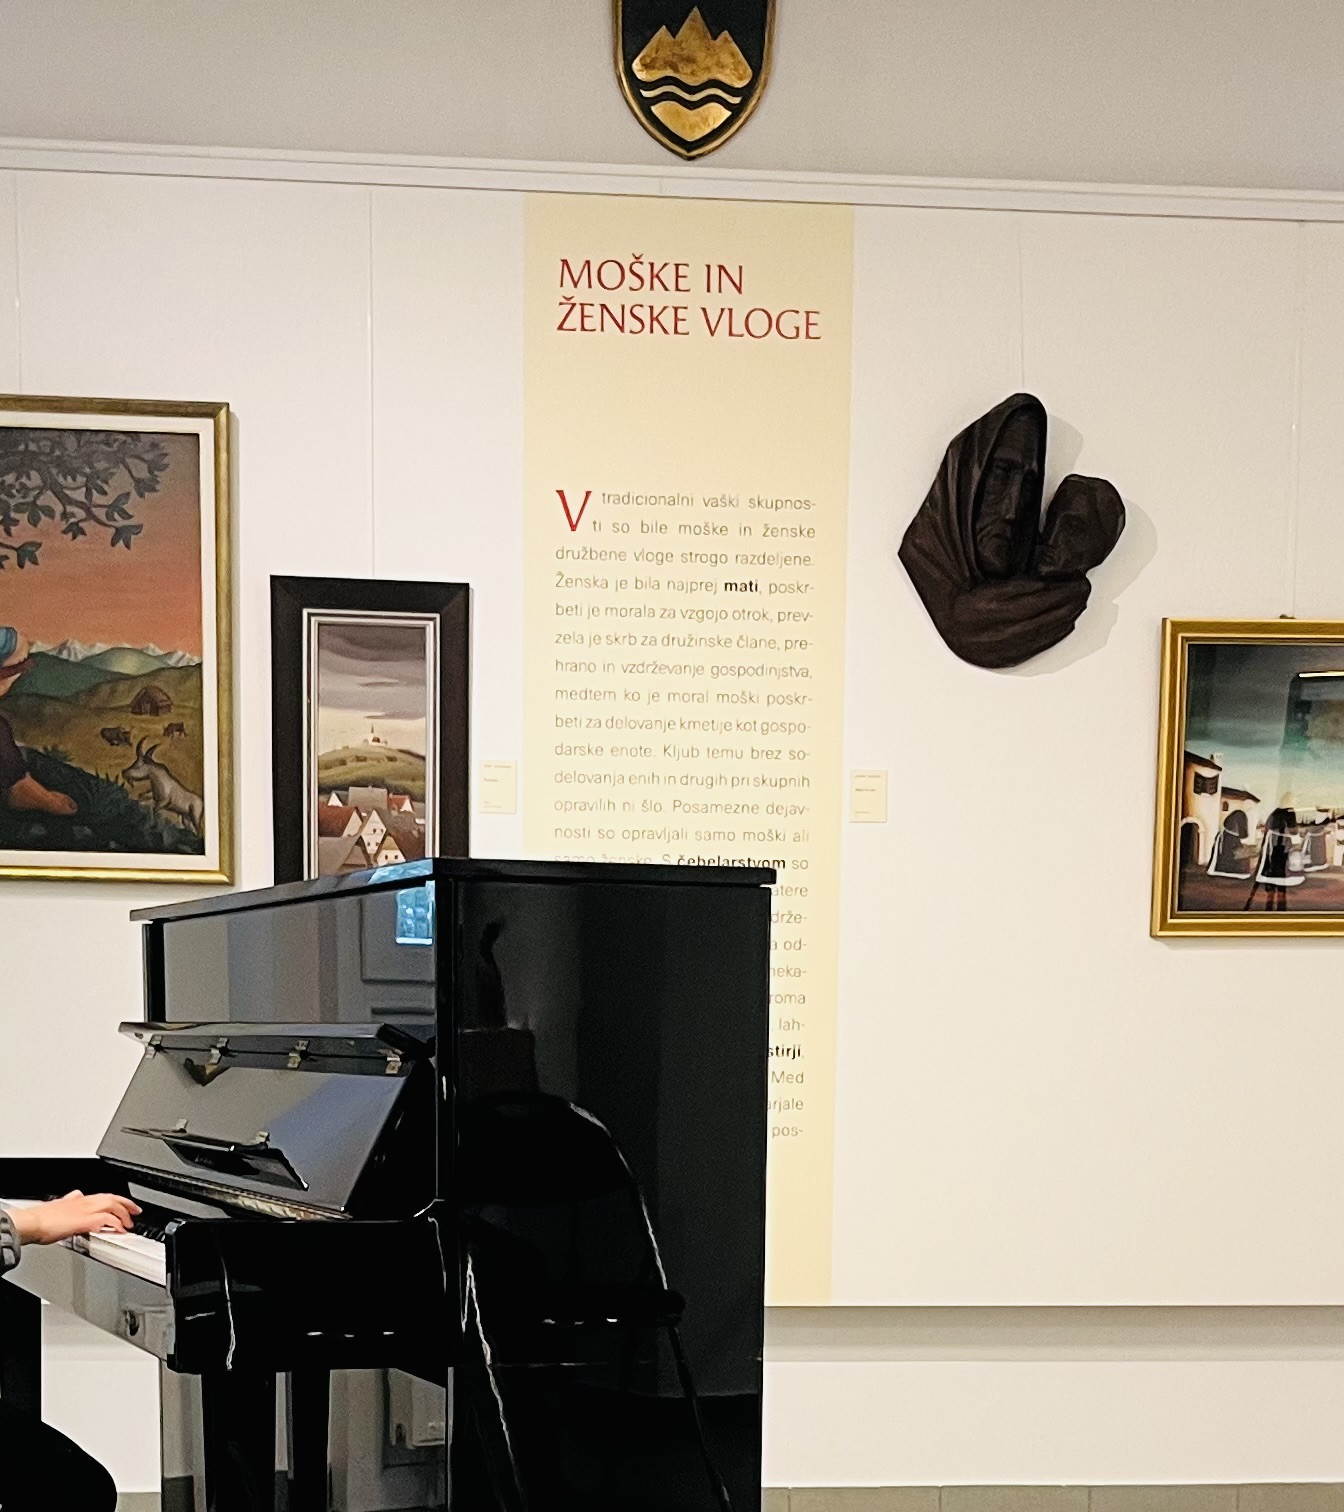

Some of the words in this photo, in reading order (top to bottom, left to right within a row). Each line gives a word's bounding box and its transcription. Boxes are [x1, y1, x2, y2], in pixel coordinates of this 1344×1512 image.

[560, 253, 691, 292] MOŠKE
[705, 264, 744, 294] IN
[557, 296, 690, 335] ŽENSKE
[701, 307, 821, 339] VLOGE
[556, 490, 592, 531] V
[602, 492, 694, 507] tradicionalni
[702, 493, 739, 508] vaški
[748, 494, 816, 512] skupnos-
[592, 520, 601, 532] ti
[612, 522, 630, 534] so
[640, 520, 668, 534] bile
[678, 521, 728, 536] moške
[739, 522, 752, 536] in
[762, 523, 816, 538] ženske
[556, 546, 626, 562] družbene
[634, 549, 674, 565] vloge
[680, 550, 728, 565] strogo
[736, 550, 815, 568] razdeljene.
[556, 571, 608, 589] Ženska
[616, 576, 628, 592] je
[634, 576, 660, 590] bila
[667, 577, 718, 594] najprej
[724, 580, 762, 594] mati,
[768, 580, 814, 595] poskr-
[556, 603, 582, 617] beti
[588, 604, 600, 619] je
[605, 604, 656, 618] morala
[660, 608, 676, 620] za
[680, 608, 728, 624] vzgojo
[732, 607, 773, 622] otrok,
[777, 610, 813, 623] prev-
[555, 632, 584, 645] zela
[588, 632, 601, 648] je
[606, 632, 636, 646] skrb
[641, 636, 657, 646] za
[661, 634, 732, 649] družinske
[736, 635, 780, 650] člane,
[784, 638, 813, 651] pre-
[556, 659, 596, 673] hrano
[603, 660, 614, 674] in
[622, 660, 704, 678] vzdrževanje
[710, 663, 812, 679] gospodinjstva,
[556, 688, 616, 701] medtem
[624, 689, 640, 702] ko
[647, 690, 660, 704] je
[668, 690, 708, 704] moral
[716, 690, 760, 704] moški
[766, 692, 812, 707] poskr-
[556, 714, 582, 728] beti
[586, 718, 602, 729] za
[606, 716, 676, 733] delovanje
[680, 717, 732, 734] kmetije
[736, 718, 756, 732] kot
[760, 721, 812, 735] gospo-
[555, 742, 603, 756] darske
[663, 744, 699, 761] Kljub
[706, 746, 743, 760] temu
[750, 746, 782, 760] brez
[788, 749, 811, 761] so-
[555, 770, 624, 786] delovanja
[629, 772, 660, 785] enih
[664, 773, 676, 786] in
[680, 772, 728, 789] drugih
[731, 774, 749, 789] pri
[753, 774, 810, 790] skupnih
[554, 798, 616, 814] opravilih
[622, 800, 634, 812] ni
[672, 800, 759, 814] Posamezne
[766, 801, 810, 818] dejav-
[554, 826, 590, 840] nosti
[598, 828, 614, 840] so
[622, 827, 688, 844] opravljali
[695, 830, 736, 842] samo
[742, 828, 786, 842] moški
[792, 830, 809, 844] ali
[677, 854, 786, 869] čebelarstvom
[792, 859, 809, 870] so
[771, 885, 809, 898] atere
[768, 1044, 805, 1060] stirji,
[771, 1070, 804, 1084] Med
[772, 1125, 803, 1139] pos-
